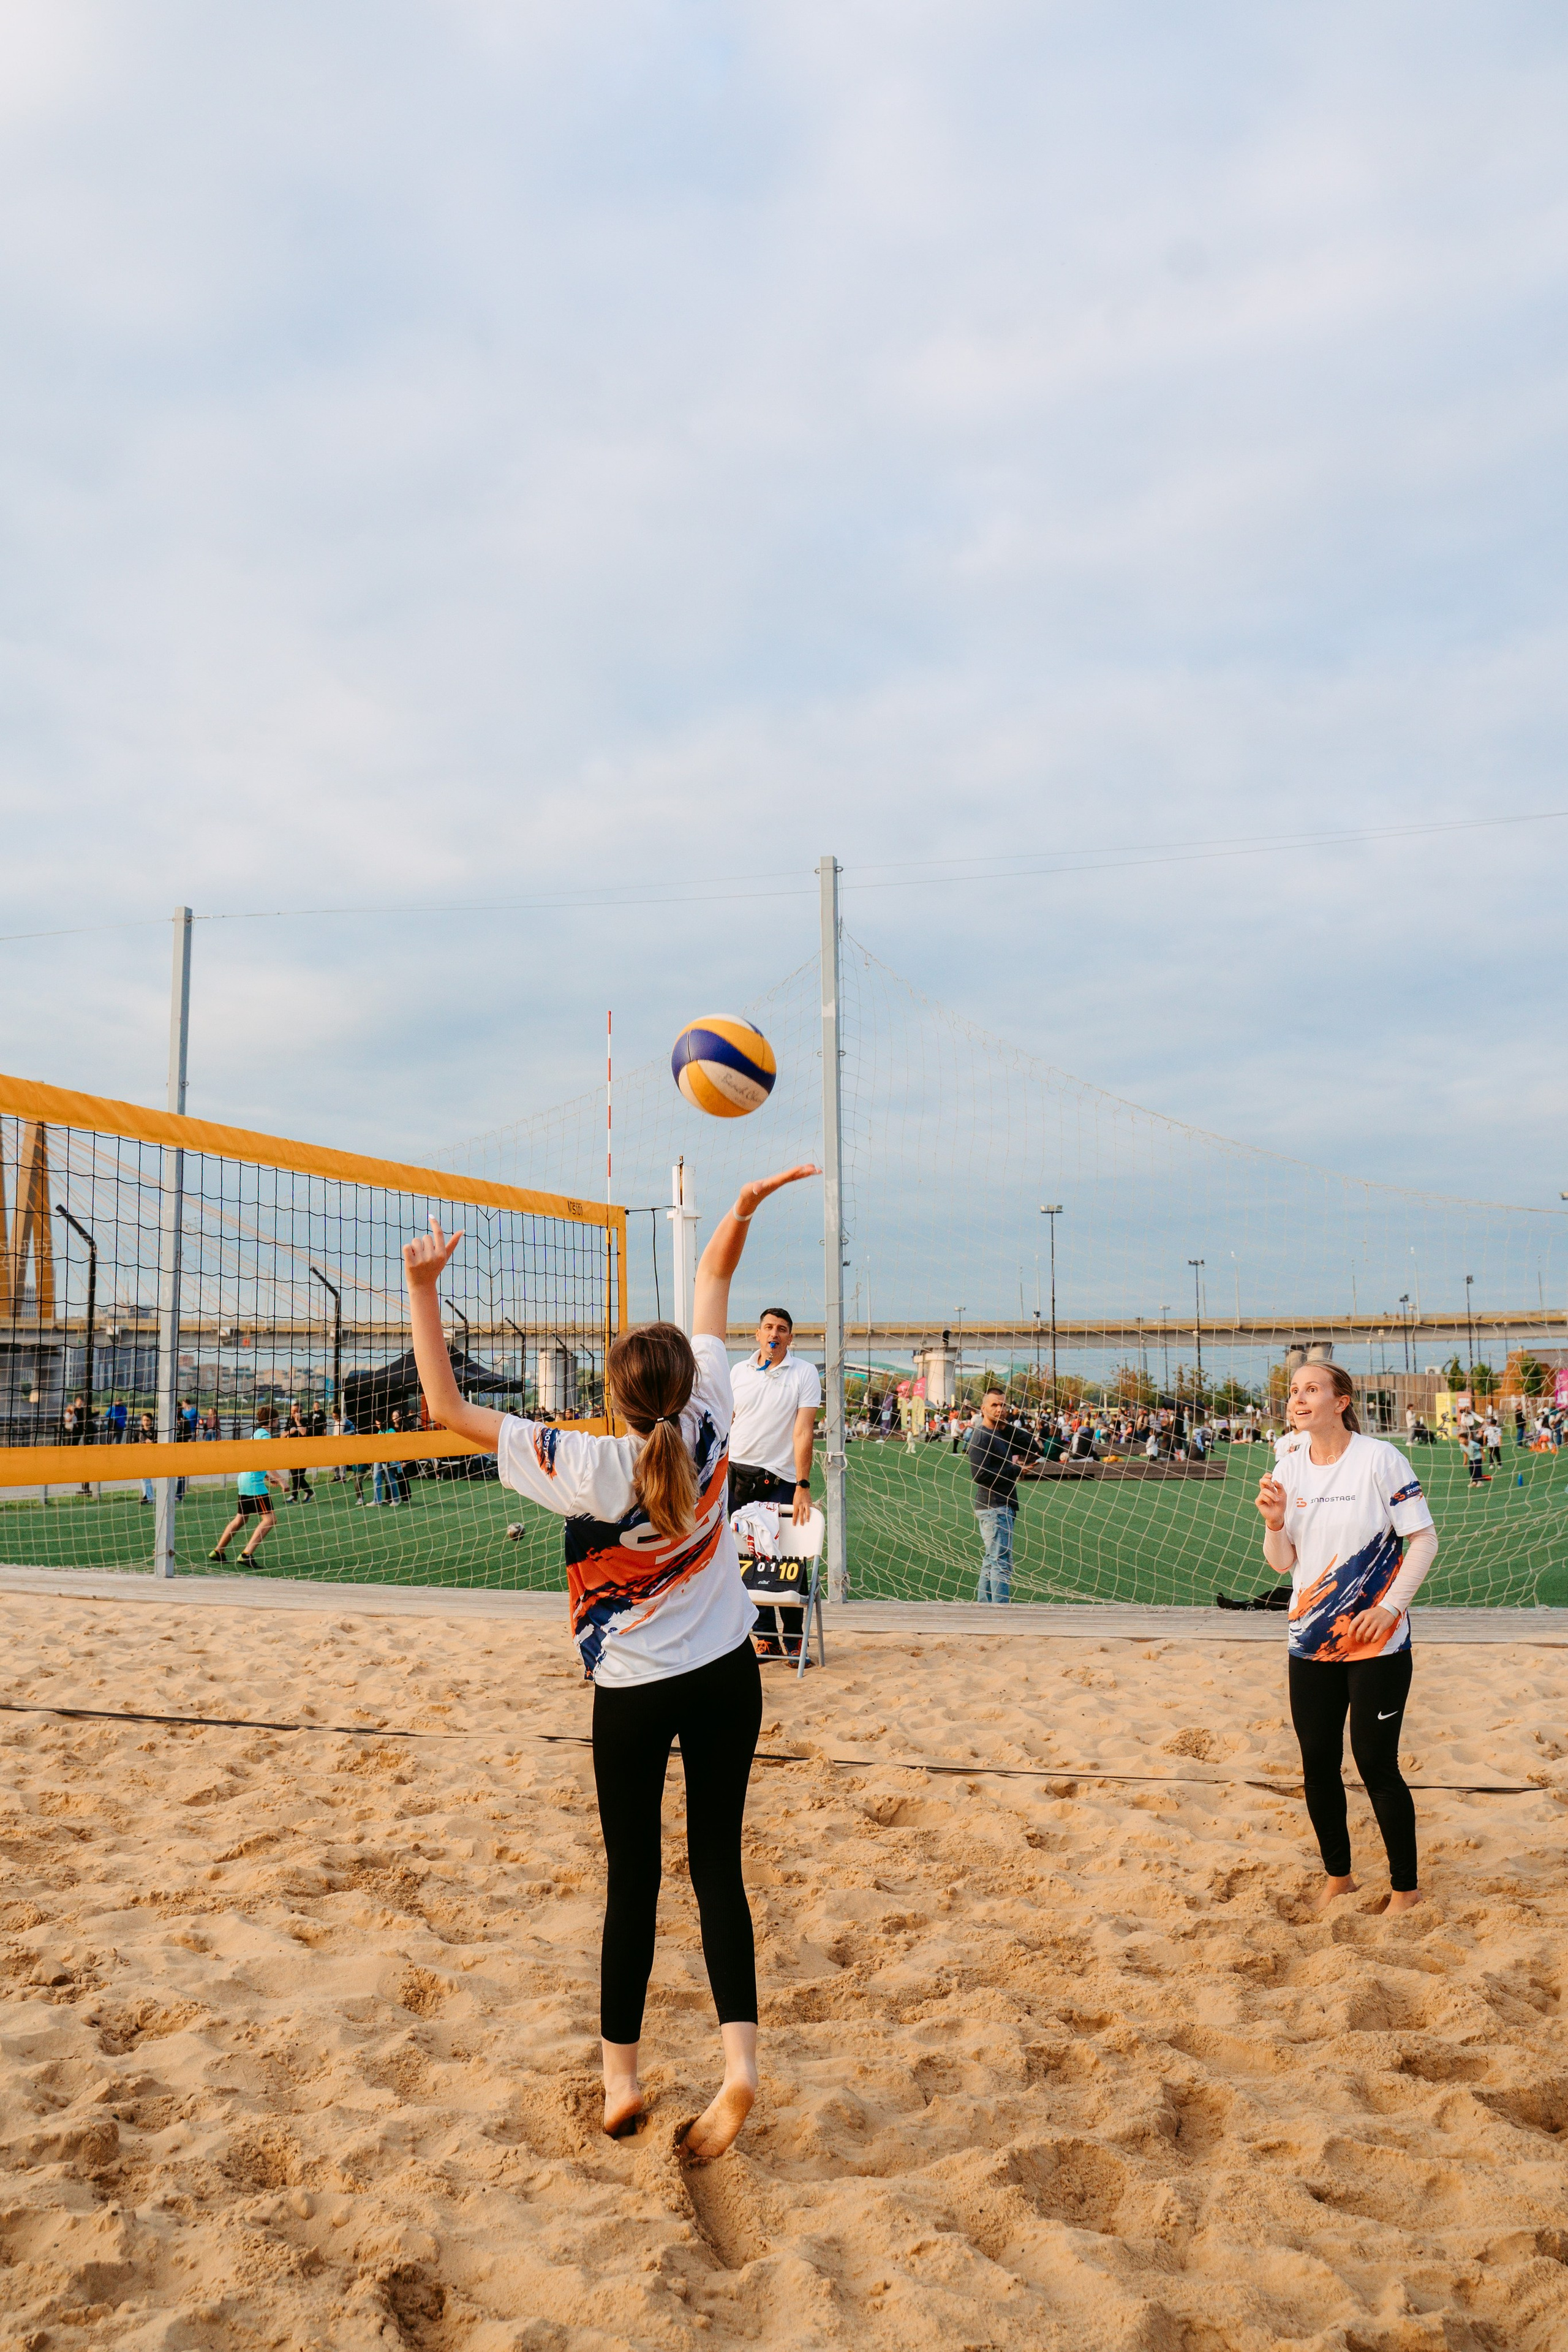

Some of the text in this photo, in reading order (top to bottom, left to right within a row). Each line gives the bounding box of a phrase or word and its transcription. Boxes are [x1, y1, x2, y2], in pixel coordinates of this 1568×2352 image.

[757, 1562, 766, 1572] 0
[770, 1562, 776, 1572] 1
[779, 1562, 799, 1580] 10
